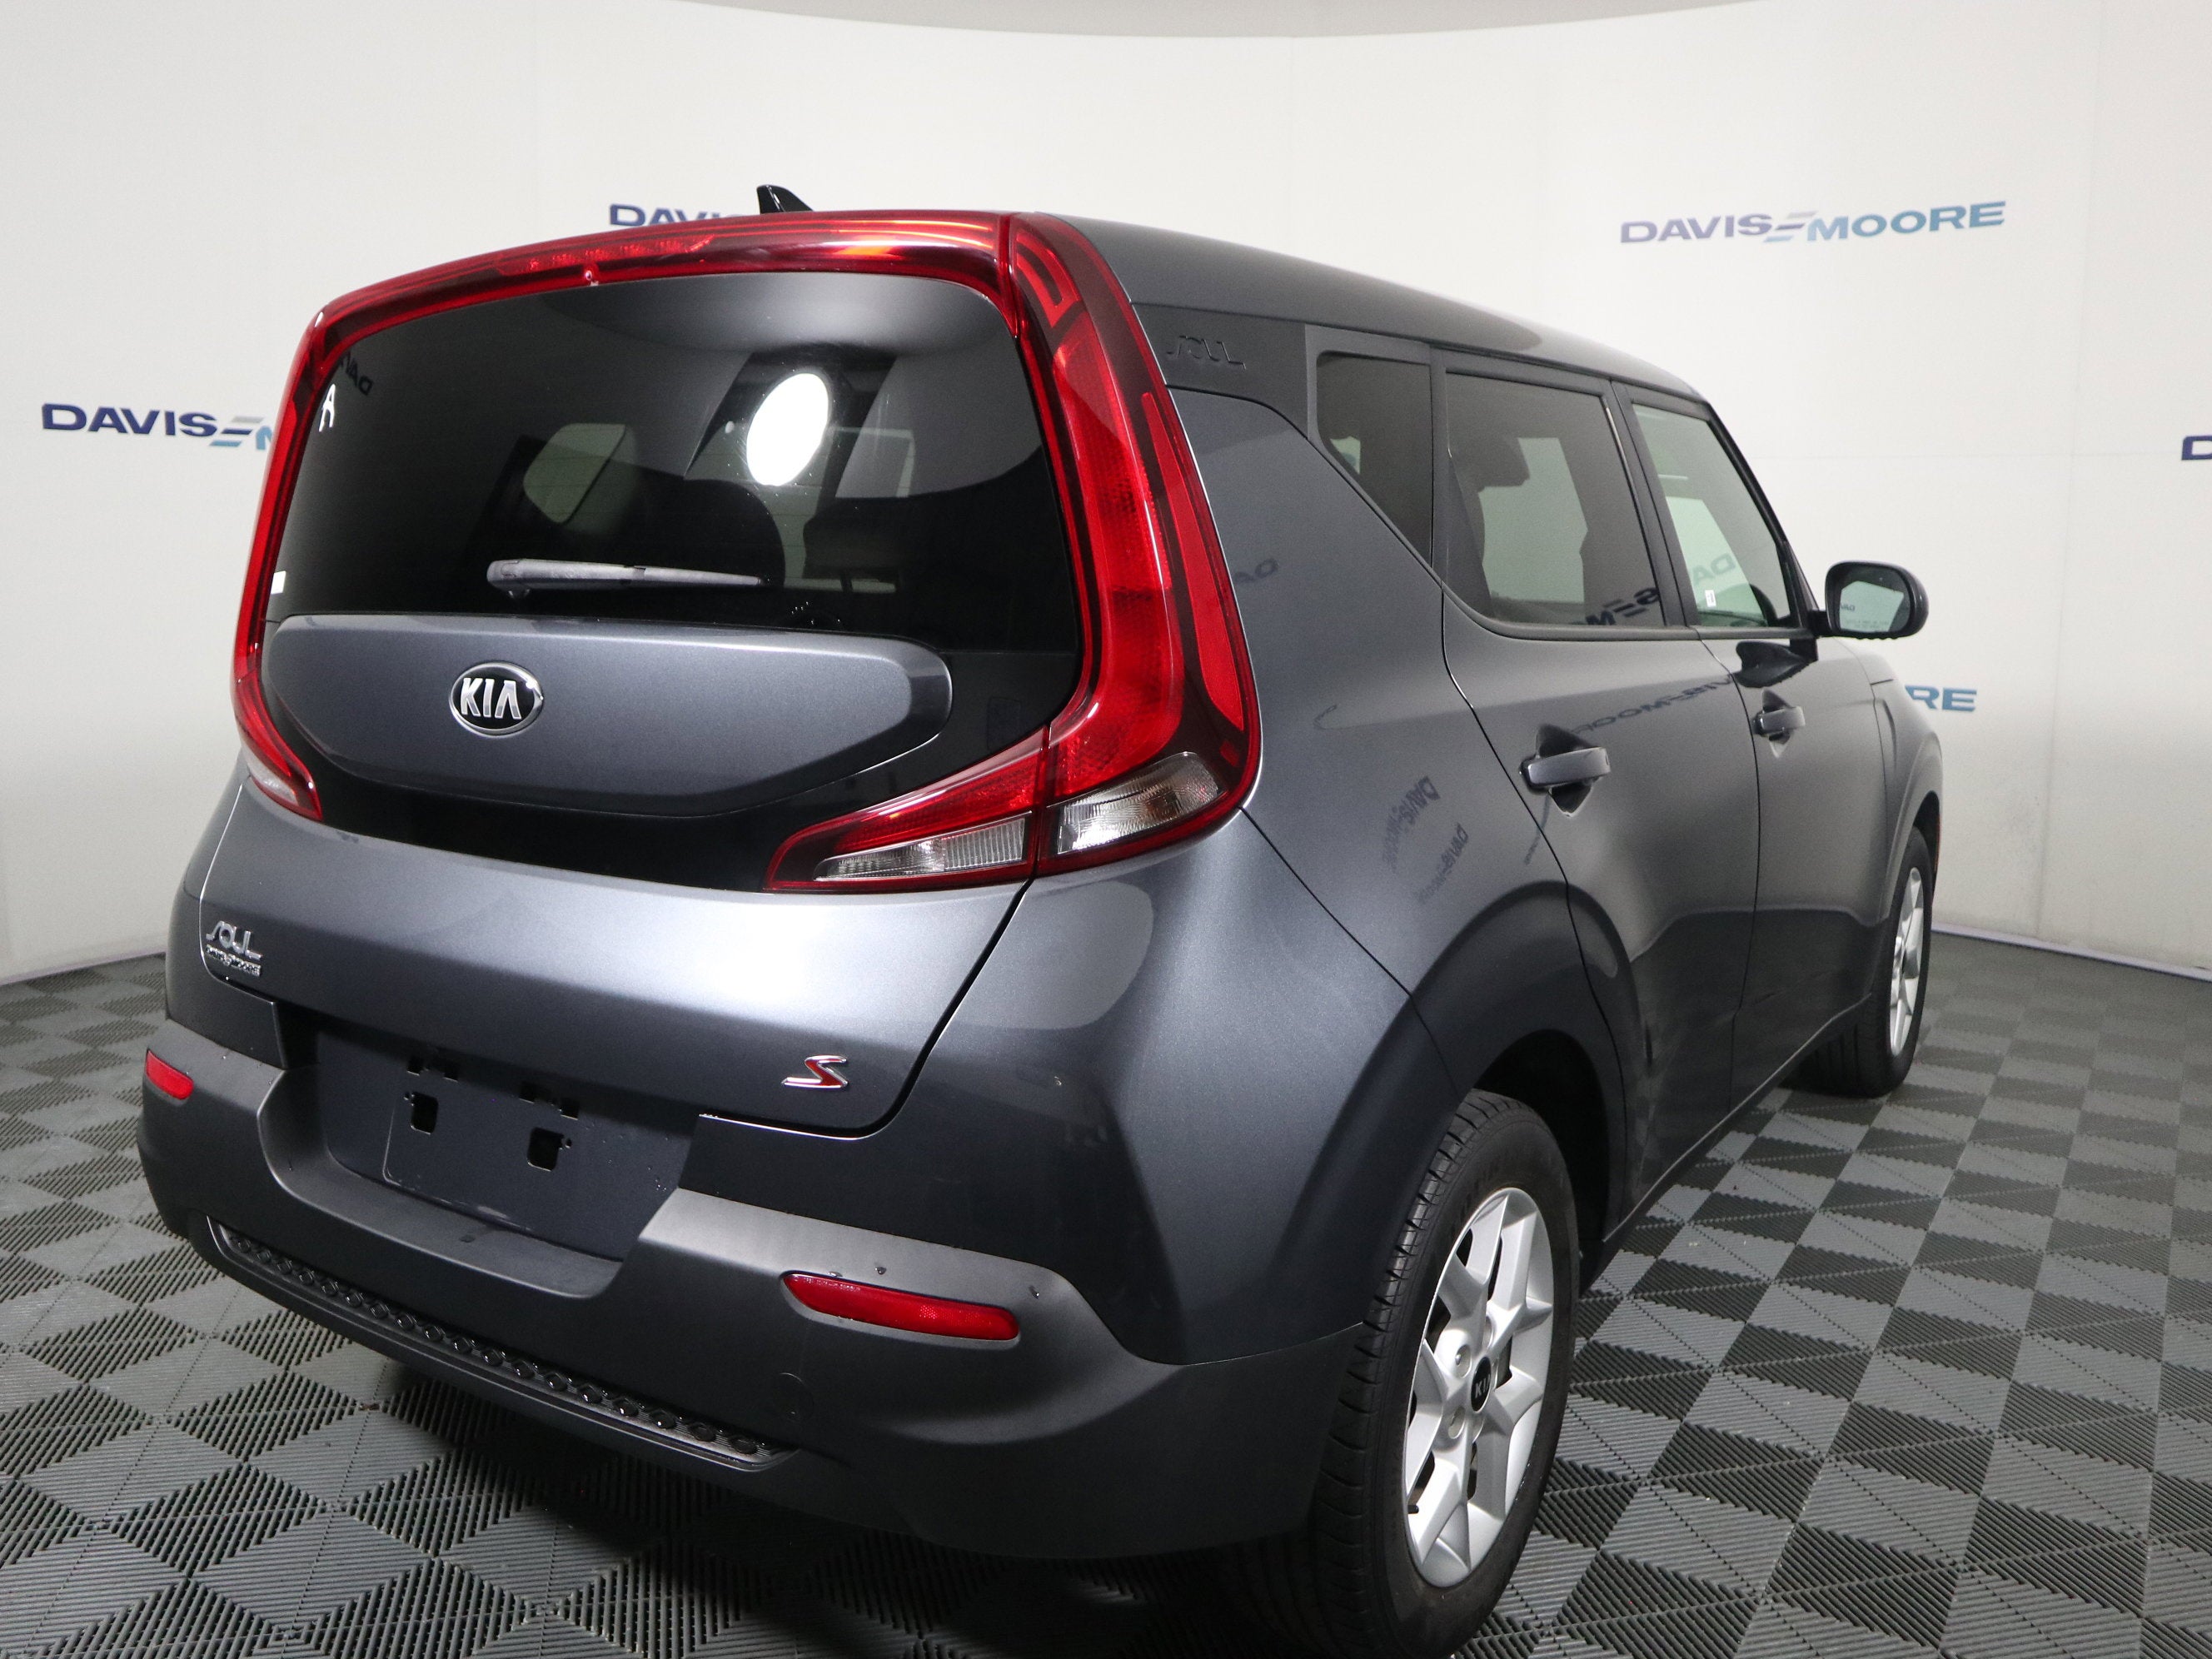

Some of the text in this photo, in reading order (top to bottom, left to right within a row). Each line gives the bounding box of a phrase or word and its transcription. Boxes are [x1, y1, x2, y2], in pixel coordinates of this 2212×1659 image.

[1621, 201, 2006, 243] DAVIS MOORE
[42, 403, 218, 437] DAVIS
[460, 677, 522, 720] KIA
[781, 1054, 848, 1089] S
